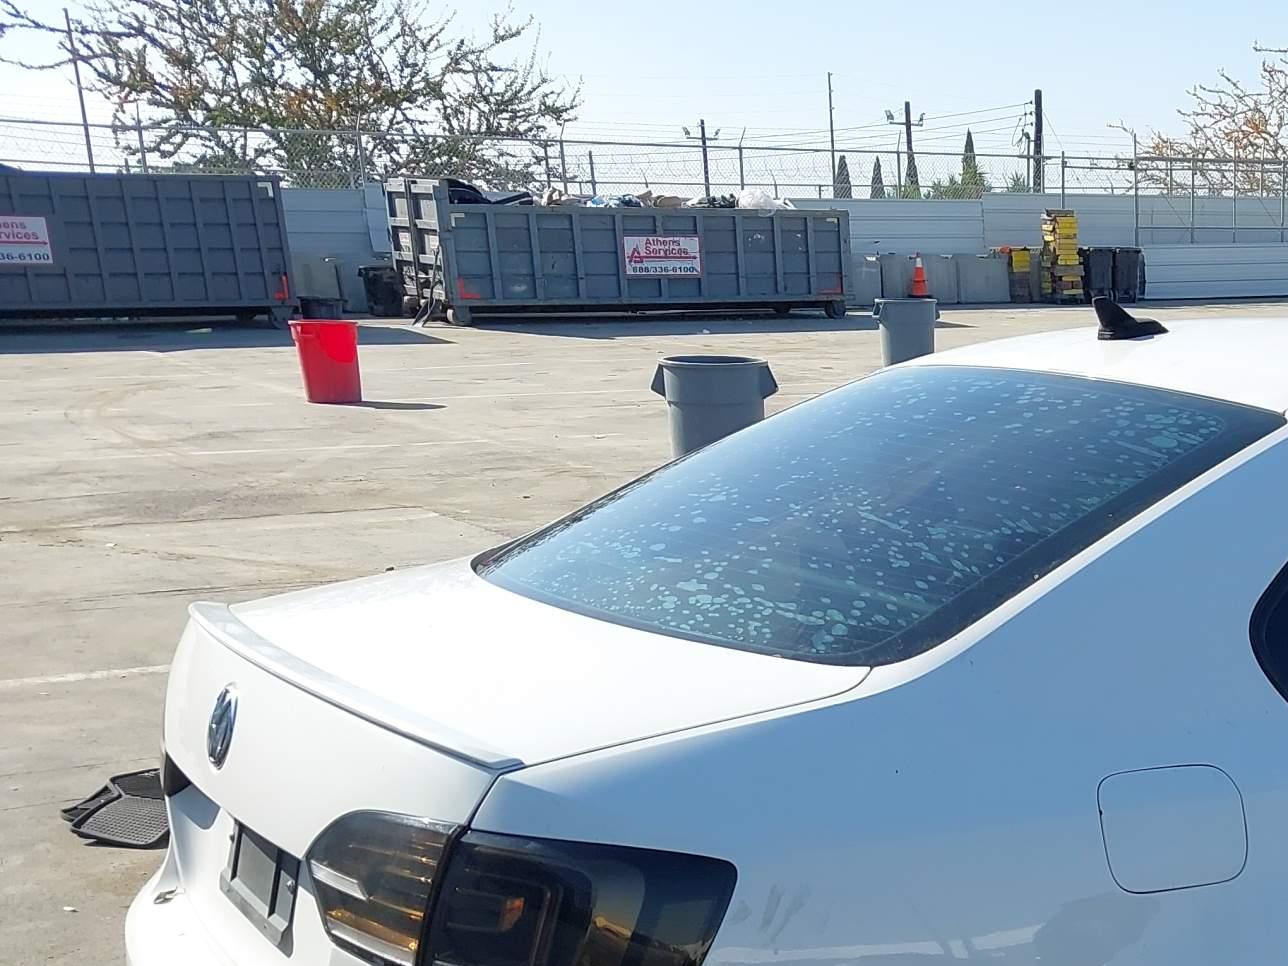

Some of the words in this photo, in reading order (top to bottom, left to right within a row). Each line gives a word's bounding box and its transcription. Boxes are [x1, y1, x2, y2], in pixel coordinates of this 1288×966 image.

[644, 238, 681, 246] Athens
[644, 245, 689, 256] Services
[632, 266, 695, 274] 888/336-6100
